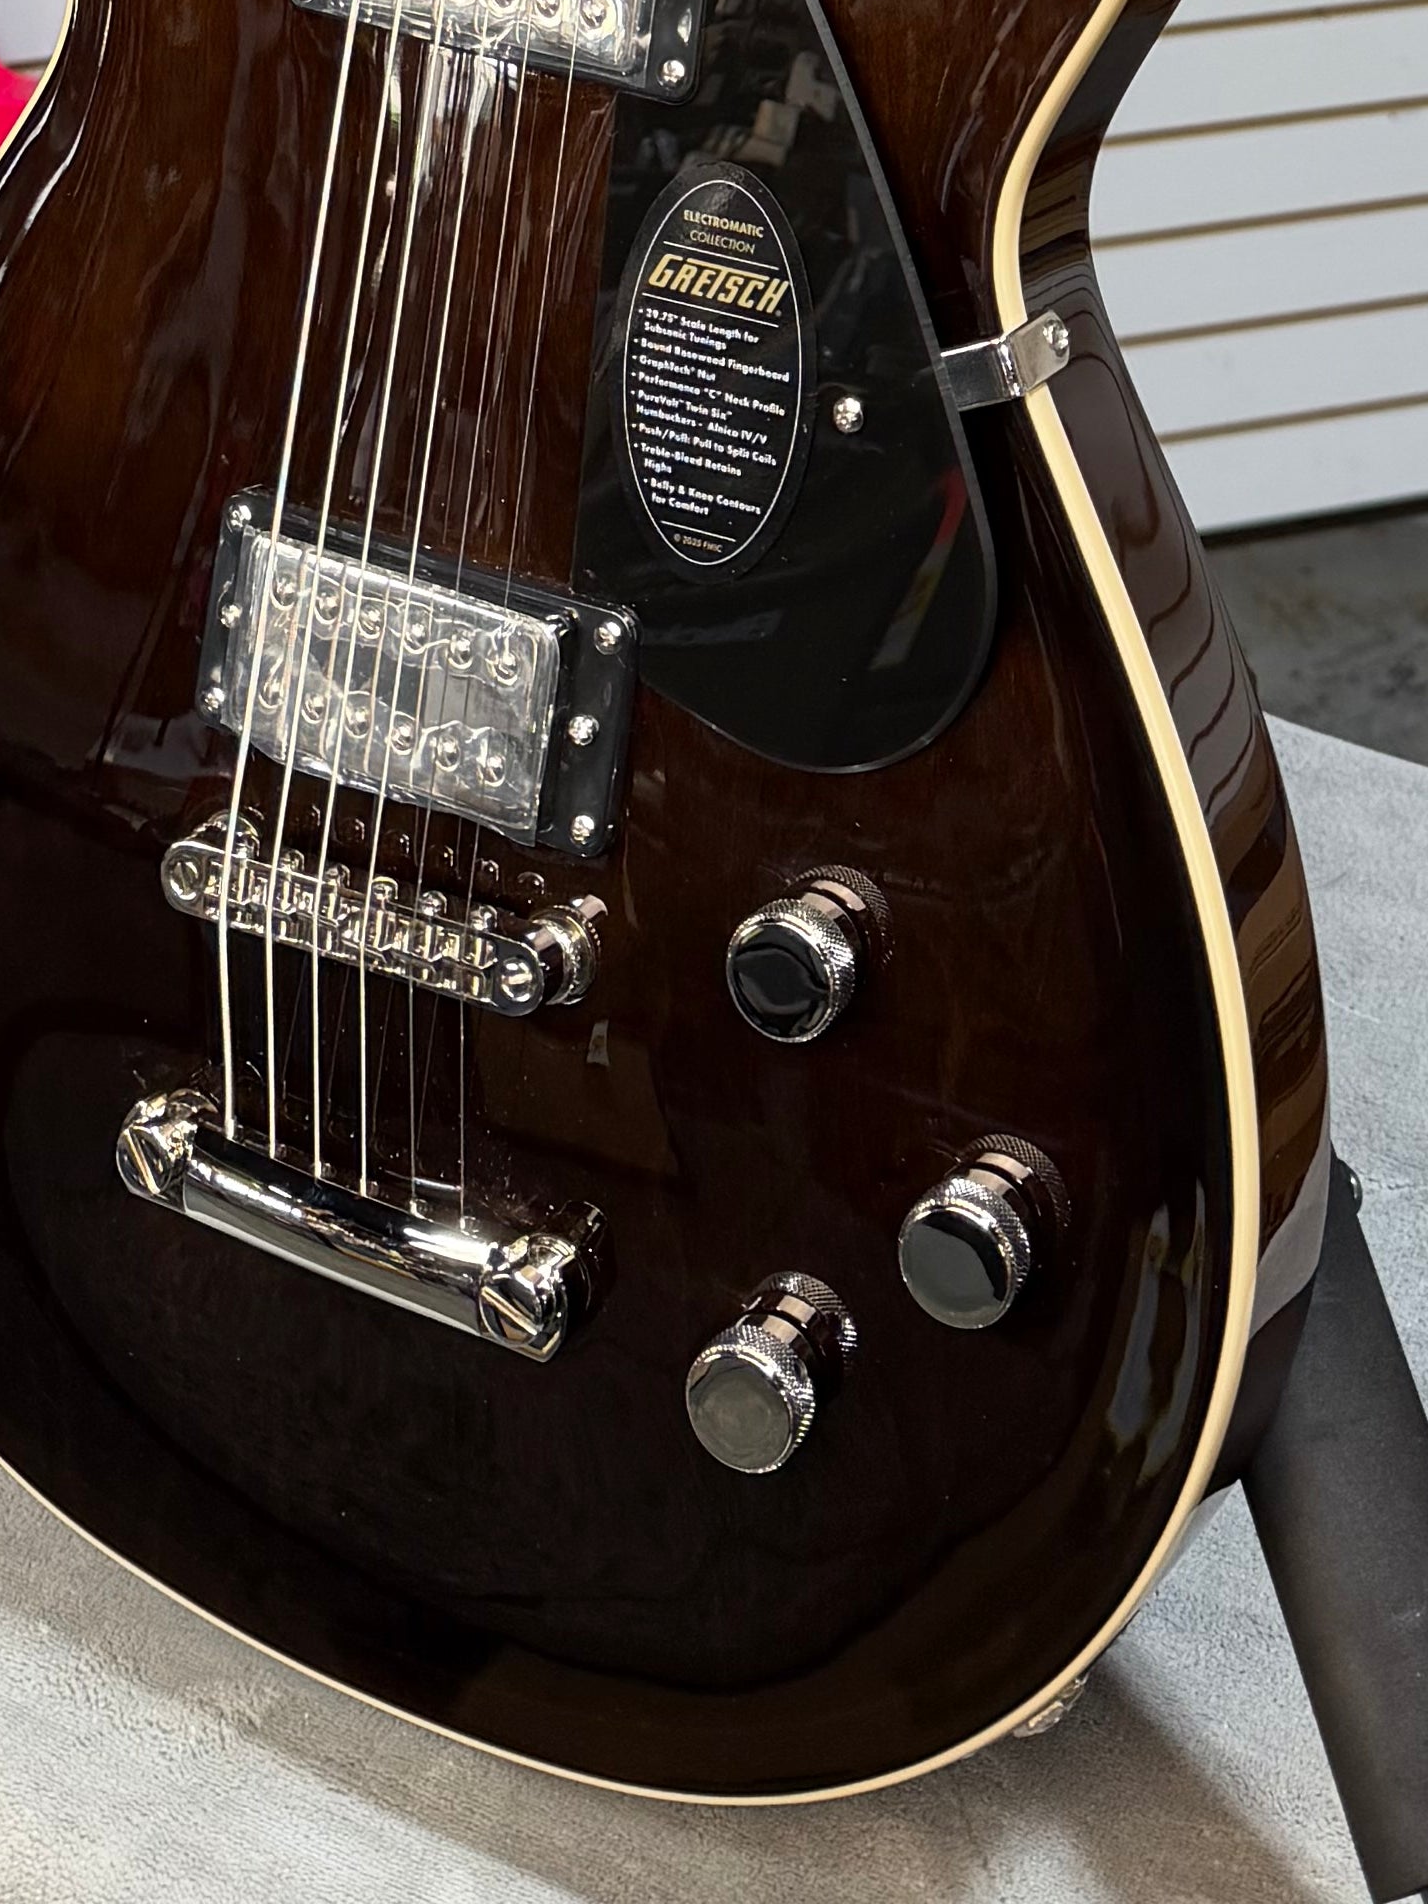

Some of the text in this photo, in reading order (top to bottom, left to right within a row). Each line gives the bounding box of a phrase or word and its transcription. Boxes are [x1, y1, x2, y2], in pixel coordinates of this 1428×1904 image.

[684, 209, 764, 239] ELECTROMATIC
[690, 230, 756, 255] COLLECTION
[648, 253, 790, 314] GRETSCH
[644, 322, 727, 350] Subsonic Tunings
[680, 317, 706, 331] Scale
[709, 324, 742, 340] Length
[744, 331, 759, 344] for
[641, 338, 790, 383] Bound Rosewood Fingerboard
[697, 369, 716, 381] Nut
[638, 371, 701, 396] Performance
[724, 393, 750, 408] Neck
[752, 399, 786, 416] Profile
[686, 401, 709, 416] Twin
[636, 404, 696, 427] Humbuckers
[707, 421, 739, 438] Alnico
[740, 429, 768, 444] IV/V
[693, 436, 712, 449] Pull
[713, 442, 725, 452] to
[727, 444, 750, 459] Split
[752, 451, 777, 466] Coils
[644, 458, 672, 474] Highs
[704, 459, 742, 476] Retains
[650, 477, 762, 515] Belly & Knee Contours
[651, 492, 709, 515] for Comfort
